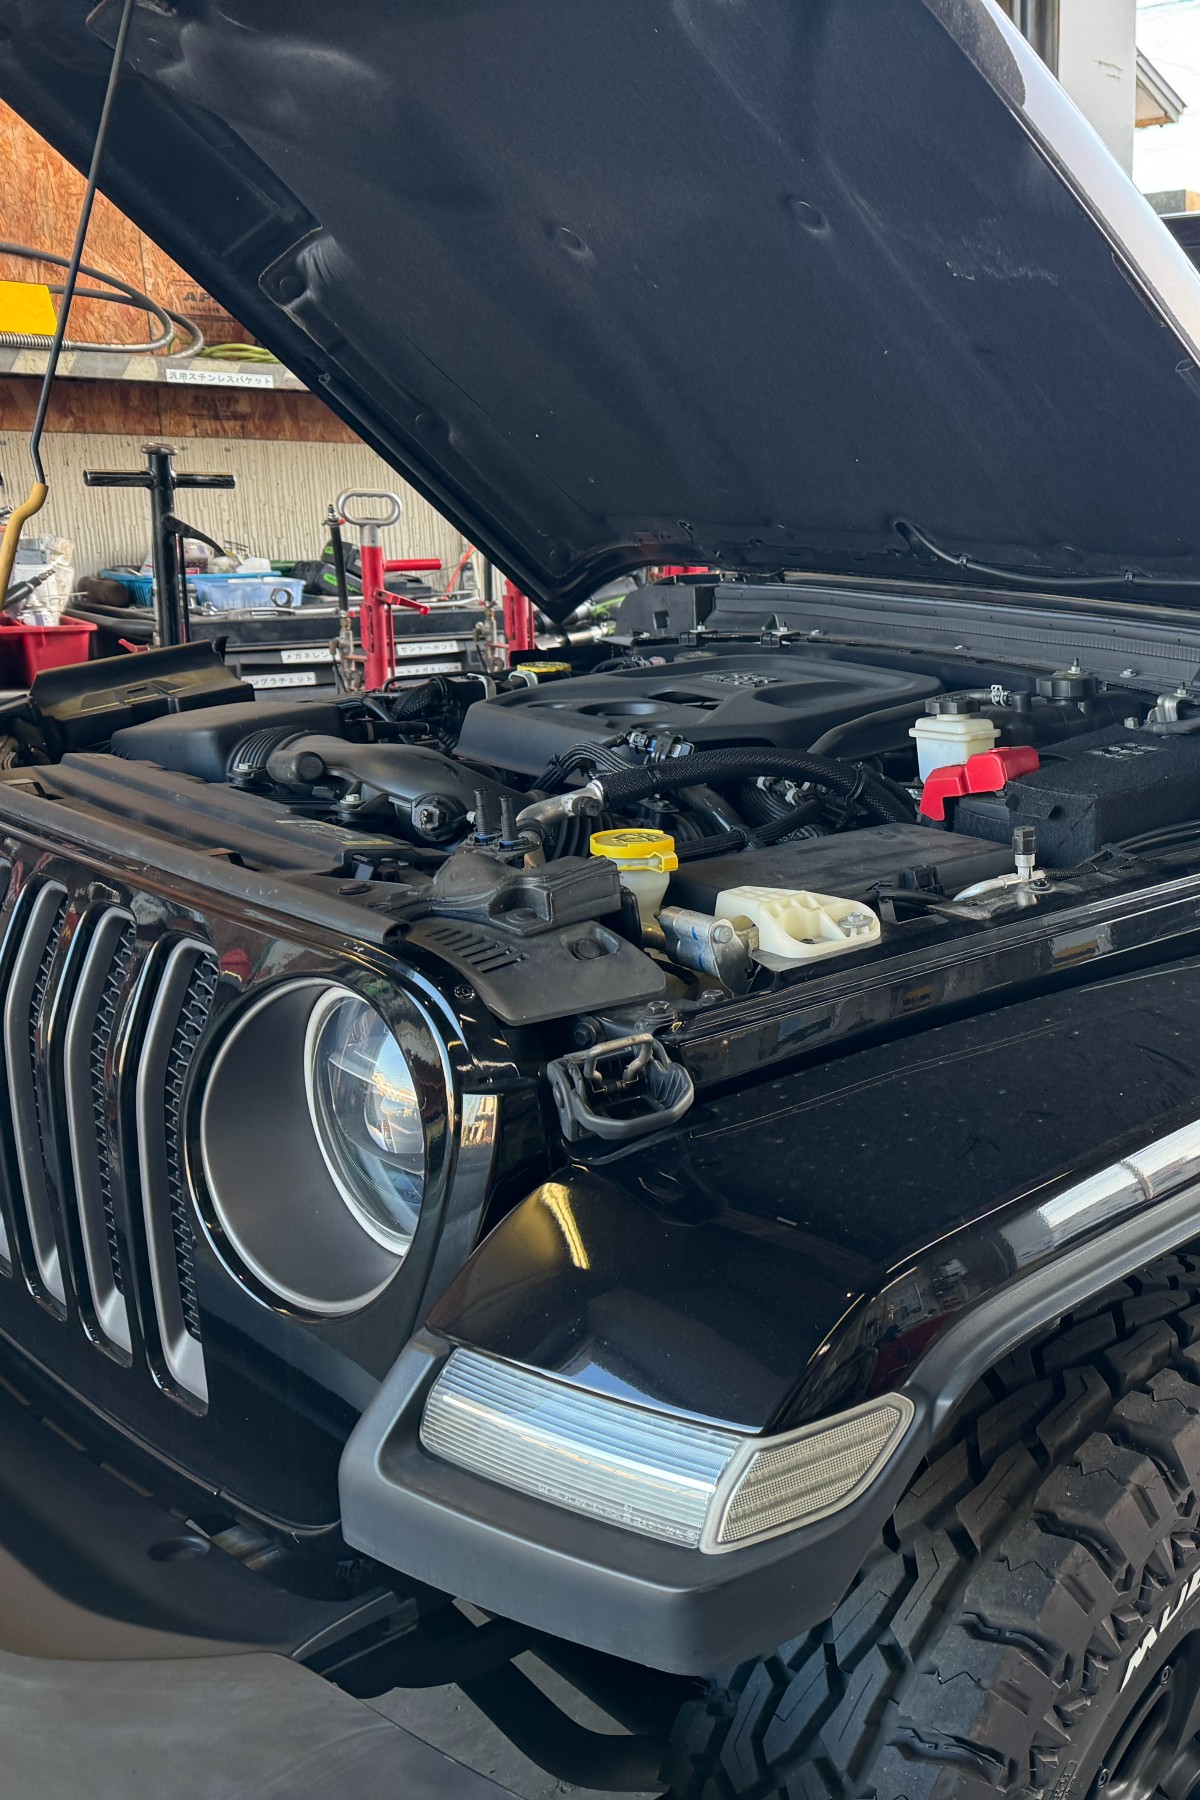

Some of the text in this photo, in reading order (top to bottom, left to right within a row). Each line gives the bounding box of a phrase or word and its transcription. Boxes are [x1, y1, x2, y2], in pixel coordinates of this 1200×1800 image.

[286, 651, 329, 661] メガネレン
[246, 675, 313, 686] ングラチェット
